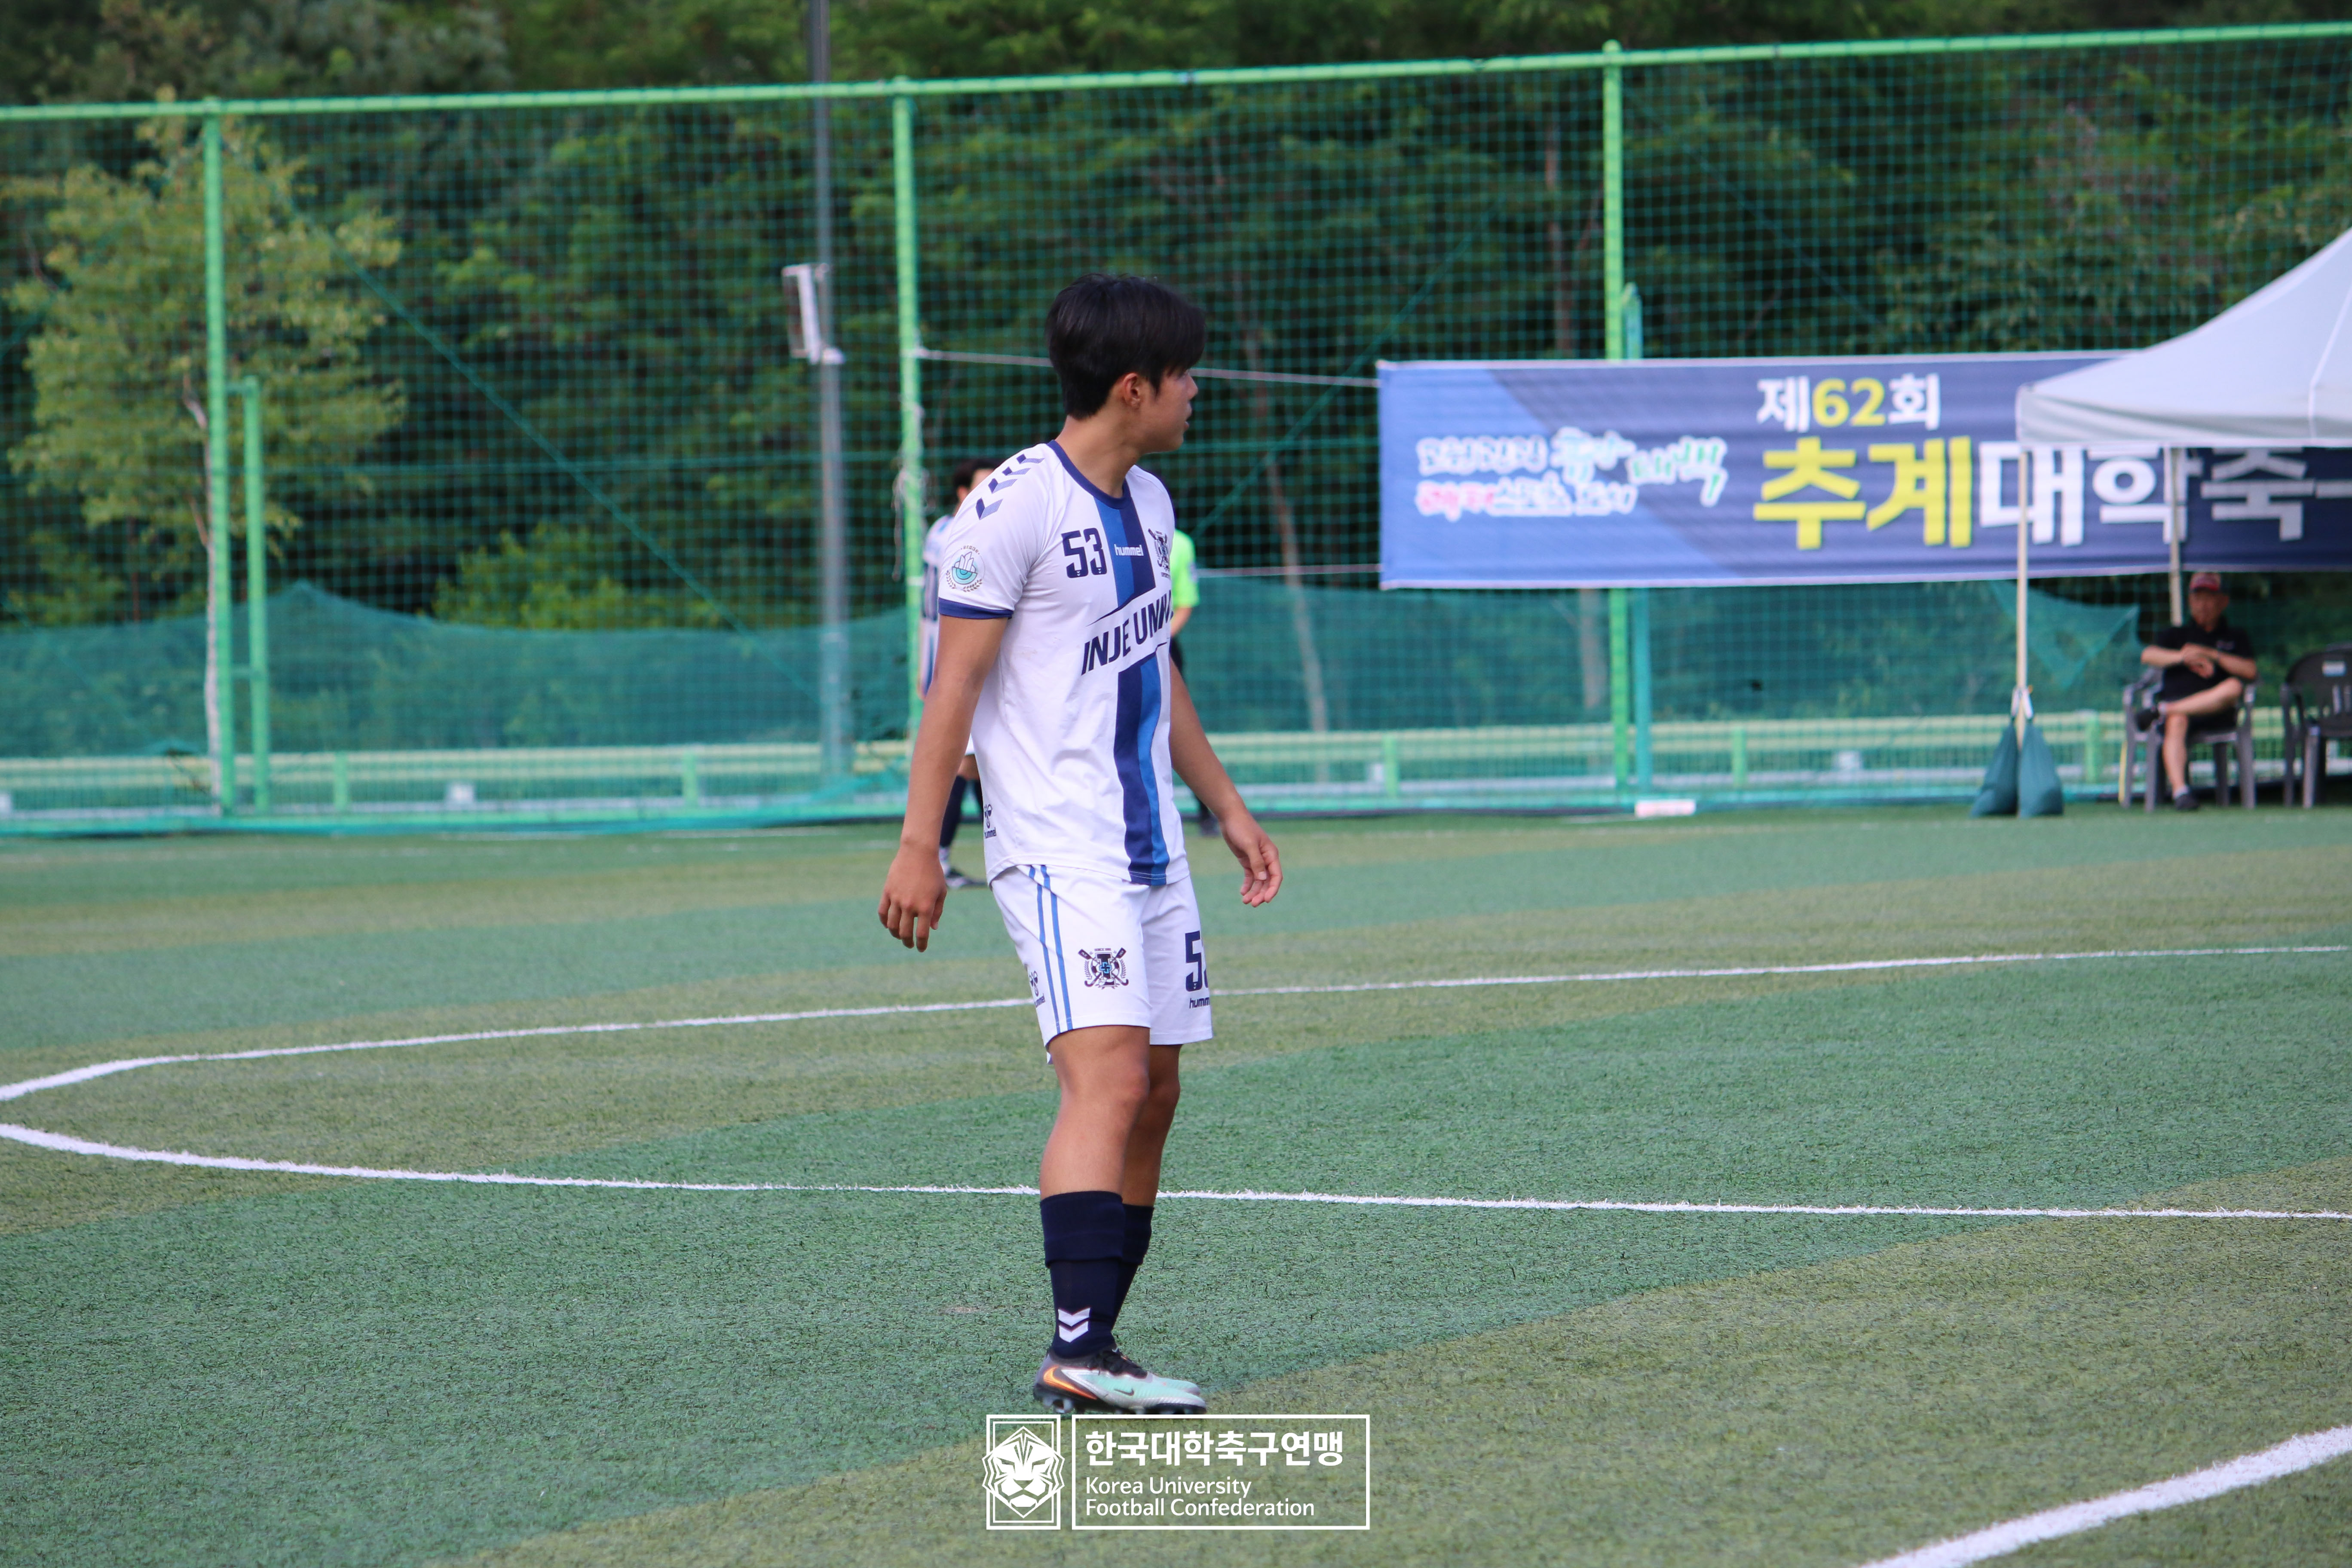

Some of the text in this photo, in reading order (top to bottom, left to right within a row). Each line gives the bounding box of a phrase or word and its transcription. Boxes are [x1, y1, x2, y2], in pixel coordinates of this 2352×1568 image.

[1756, 372, 1941, 432] 제62회
[1753, 435, 2352, 549] 추계대학축
[1061, 528, 1107, 578] 53
[1114, 543, 1144, 557] hummel
[1081, 618, 1131, 676] INJE
[1185, 930, 1209, 992] 5
[1034, 993, 1045, 1008] ummel
[1189, 997, 1210, 1009] humm
